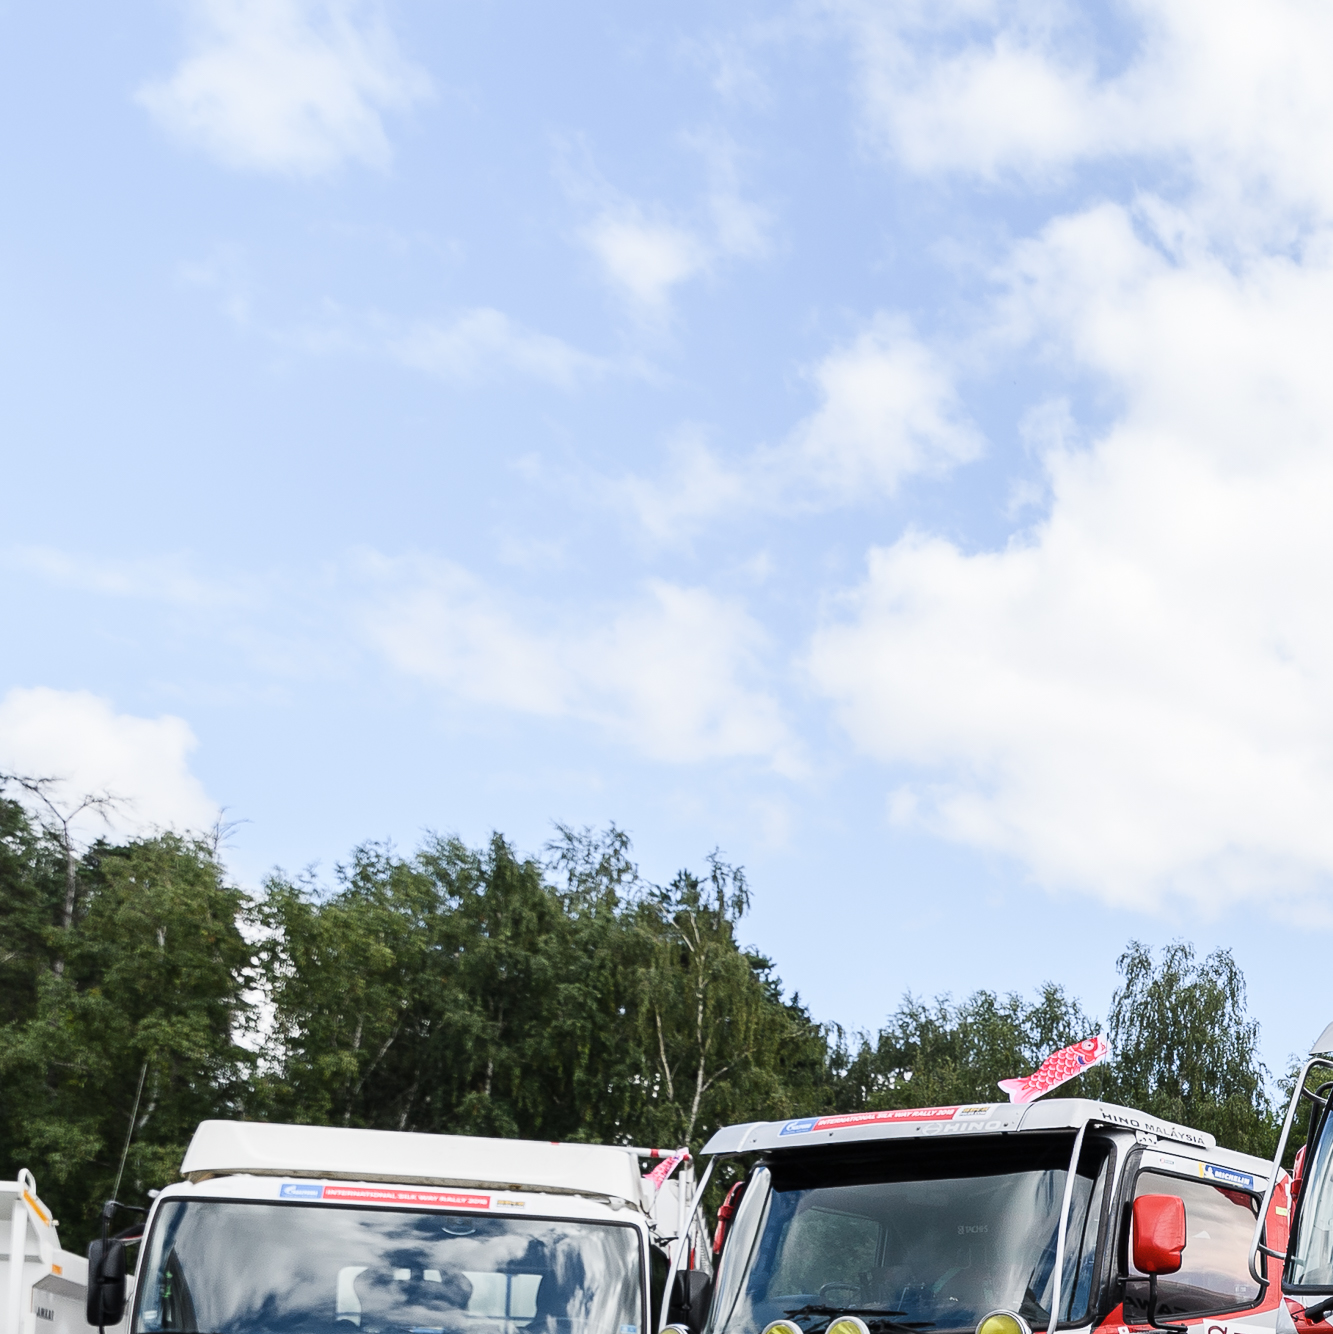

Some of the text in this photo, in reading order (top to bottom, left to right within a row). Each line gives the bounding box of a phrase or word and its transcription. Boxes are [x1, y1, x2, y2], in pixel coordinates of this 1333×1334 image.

[943, 1121, 1001, 1133] HINO
[1101, 1111, 1139, 1128] HINO
[1144, 1123, 1206, 1146] MALAYSIA
[1214, 1170, 1251, 1186] MICHELIN
